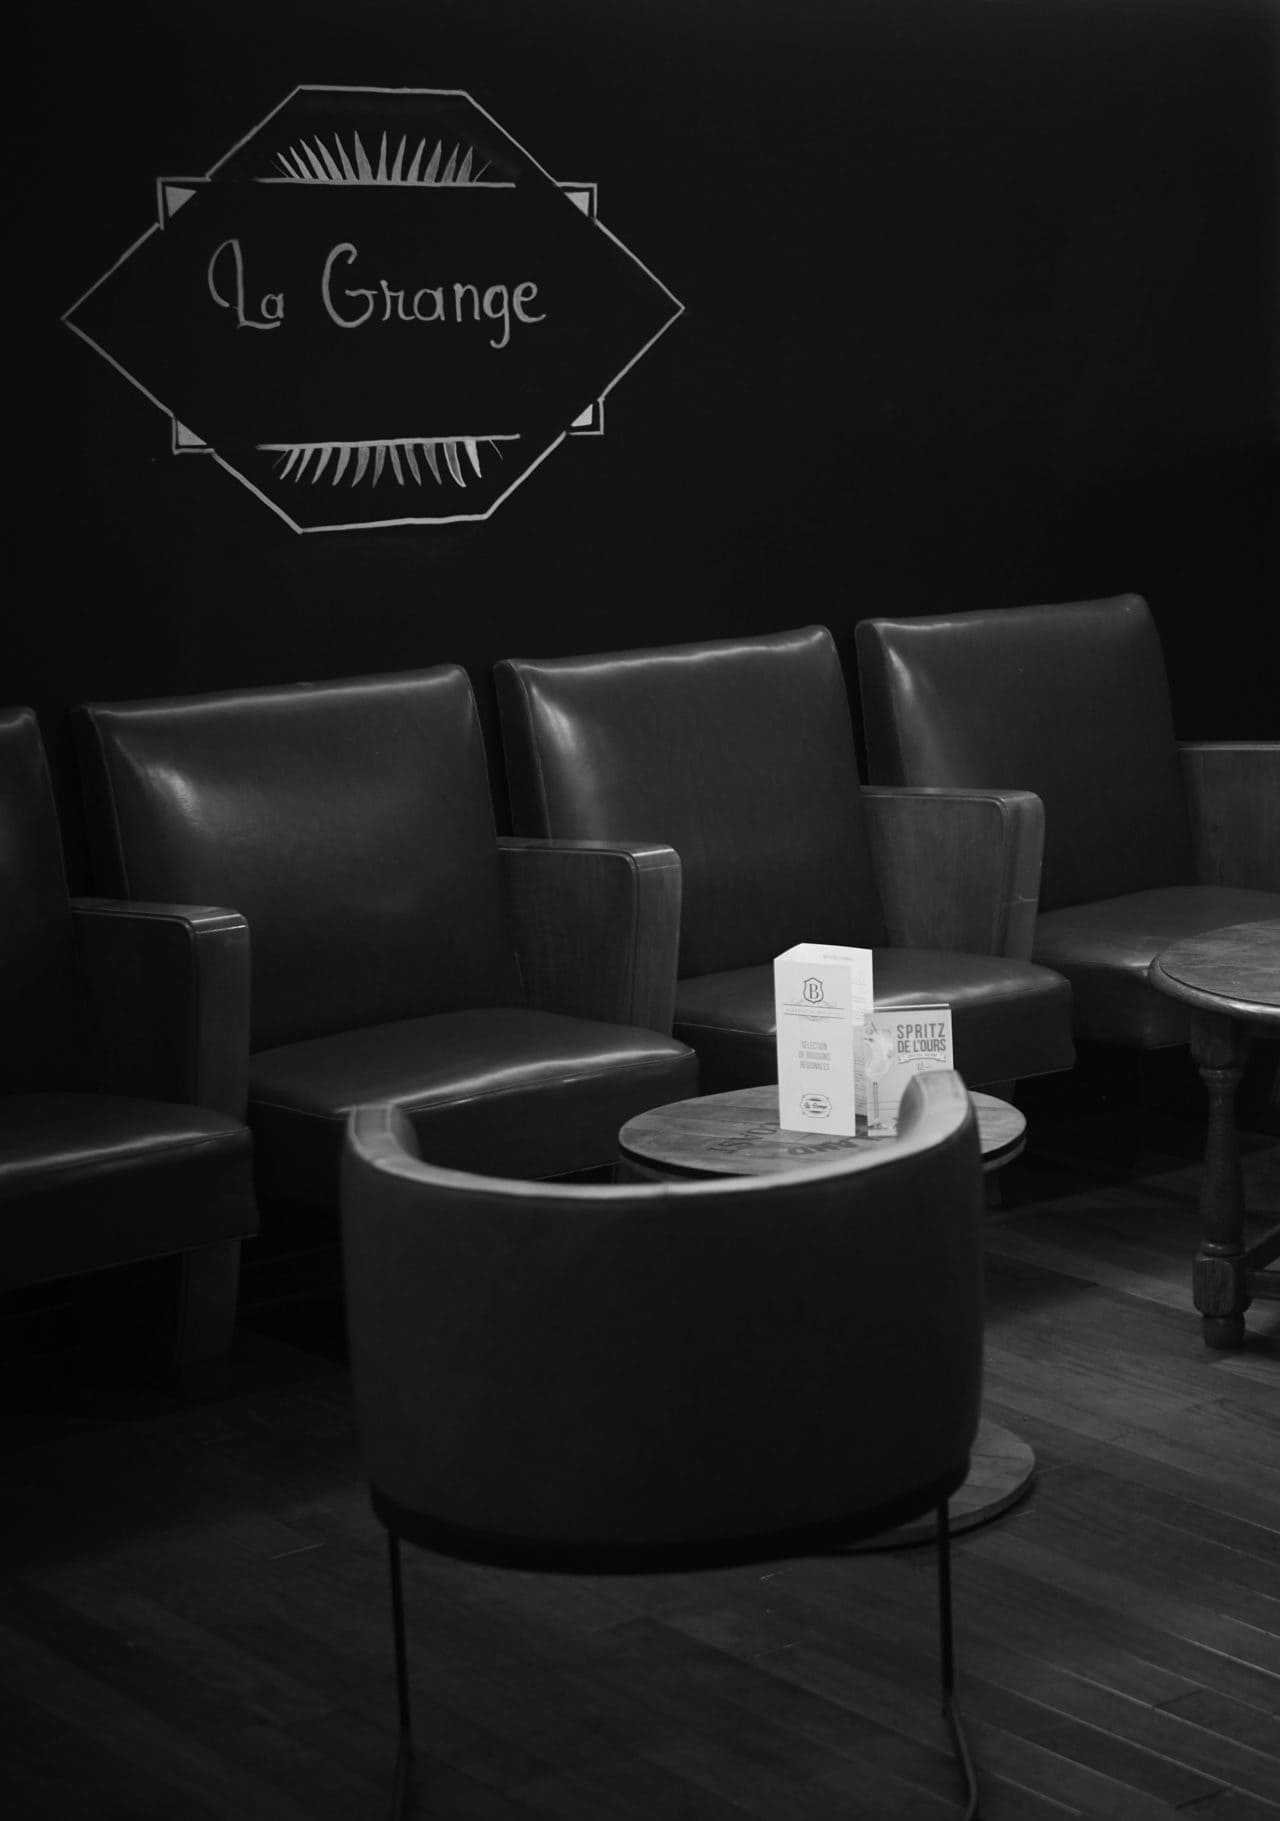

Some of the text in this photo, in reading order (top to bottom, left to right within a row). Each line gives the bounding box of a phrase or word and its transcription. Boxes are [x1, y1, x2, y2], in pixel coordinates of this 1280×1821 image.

[208, 239, 546, 349] La Grange
[809, 983, 819, 1000] B
[897, 1022, 945, 1039] SPRITZ
[897, 1038, 946, 1053] DE L'OURS
